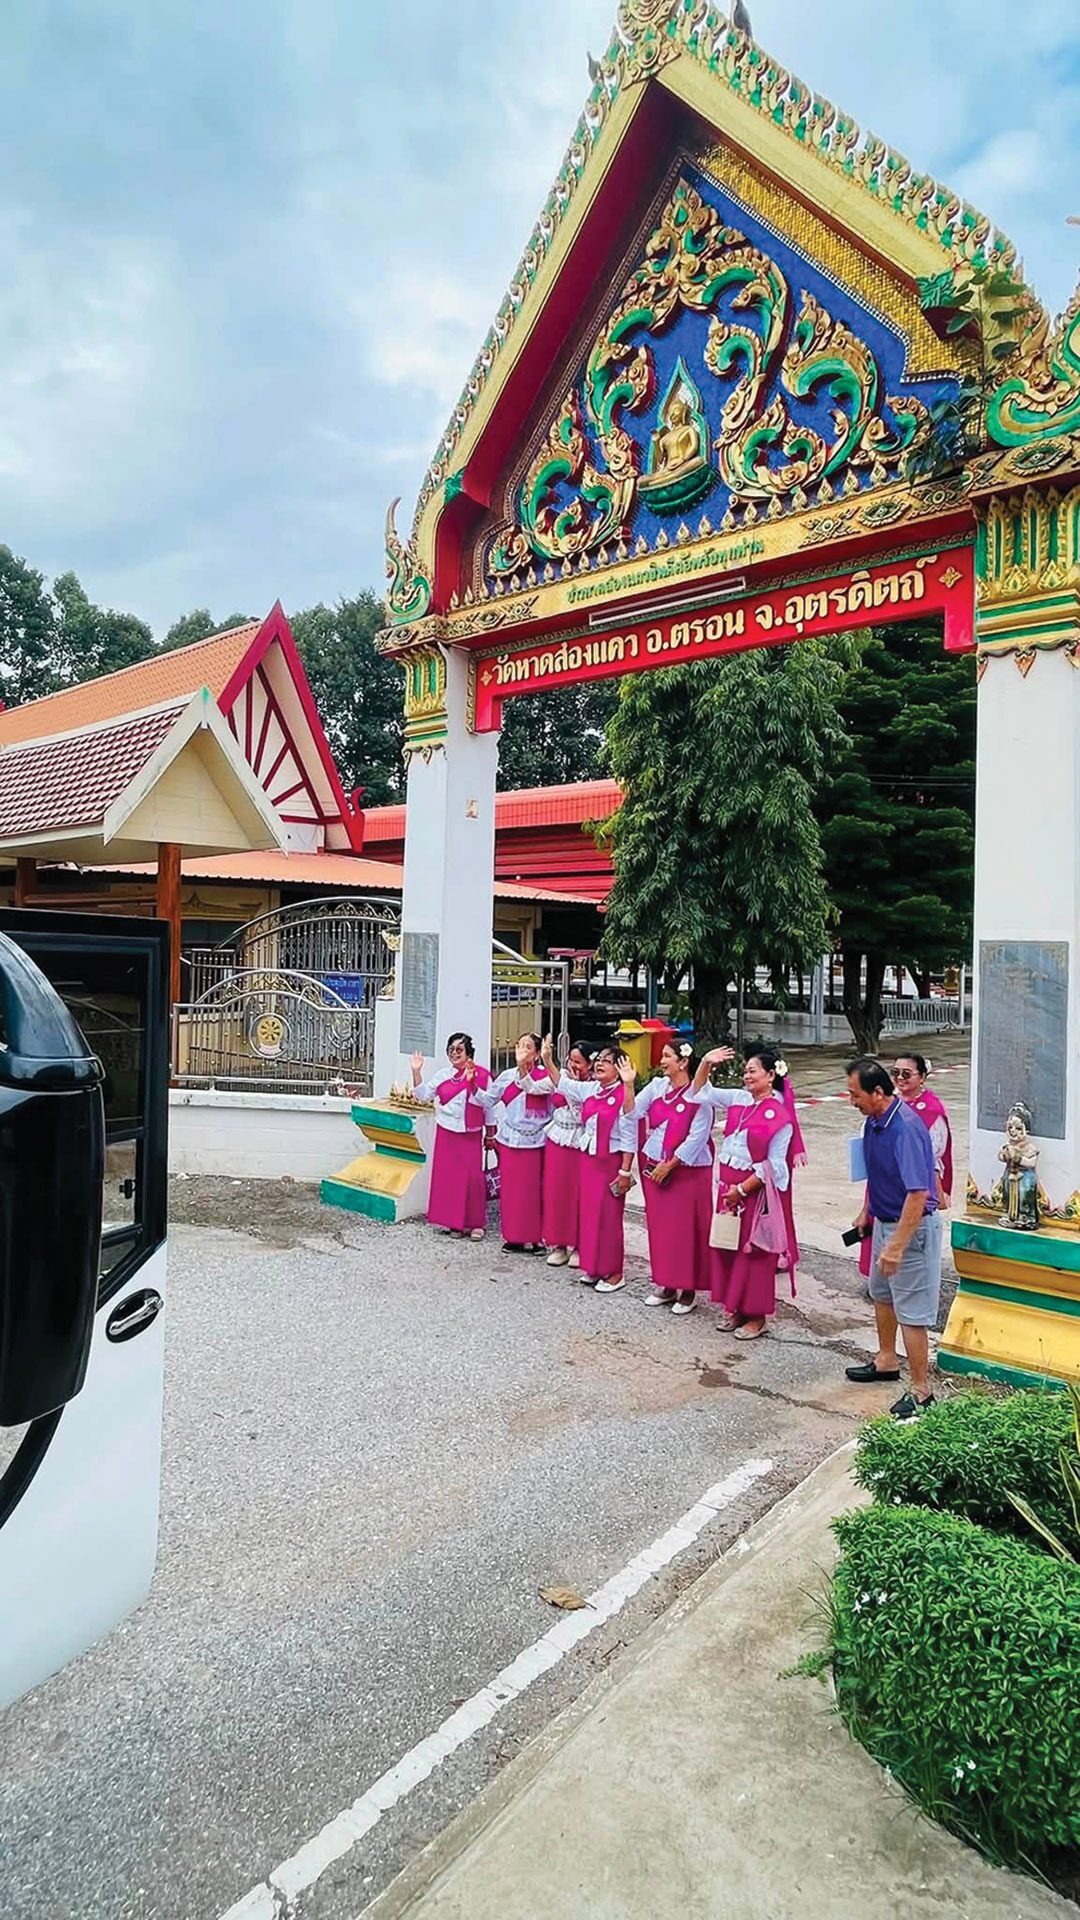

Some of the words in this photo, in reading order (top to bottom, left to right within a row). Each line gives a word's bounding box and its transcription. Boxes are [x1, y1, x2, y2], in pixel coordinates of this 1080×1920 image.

[492, 633, 639, 685] วัดหาดสองแคว
[646, 609, 745, 653] อ.ตรอน
[755, 555, 938, 633] จ.อุตรดิตถ์
